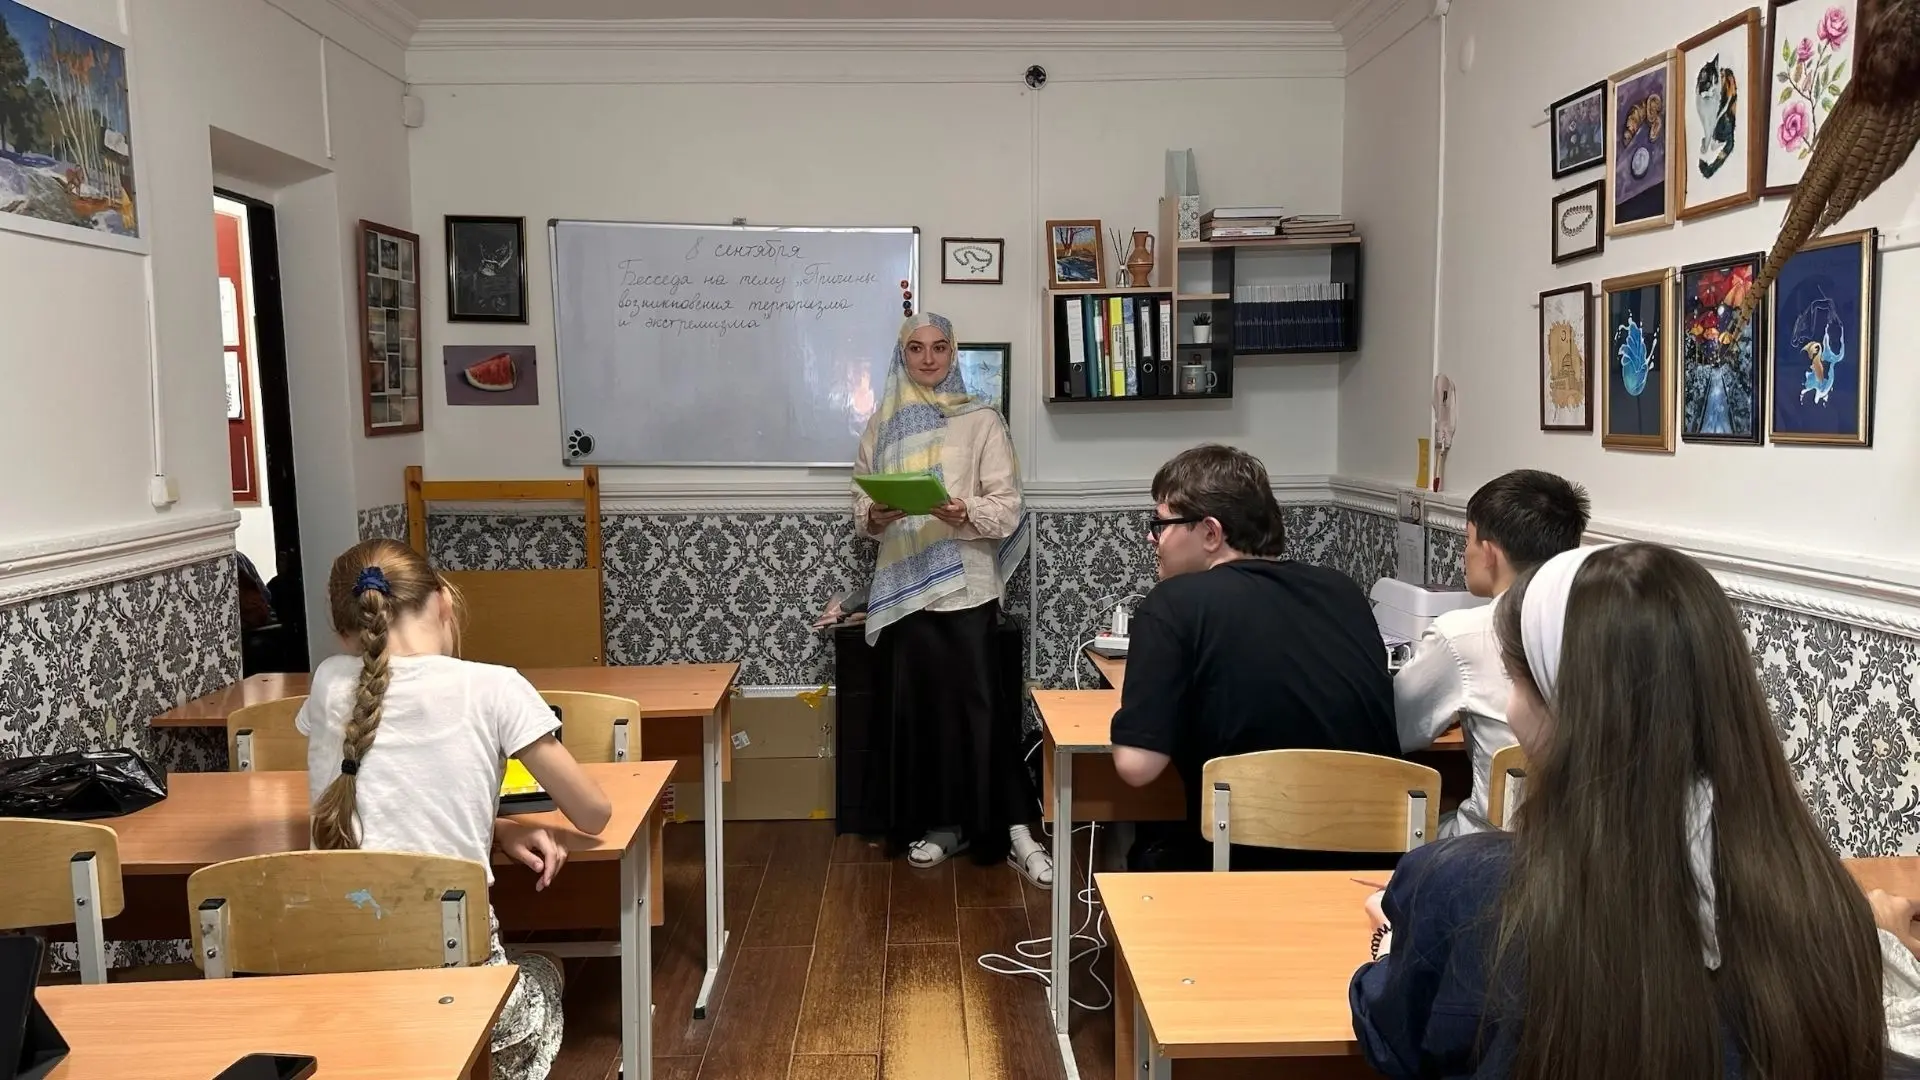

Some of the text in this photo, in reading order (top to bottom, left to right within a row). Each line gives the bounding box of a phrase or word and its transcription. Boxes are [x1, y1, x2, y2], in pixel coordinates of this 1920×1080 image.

[685, 236, 809, 266] 8 сентября
[703, 275, 729, 286] на
[740, 275, 786, 293] тему
[748, 299, 854, 320] терроризма
